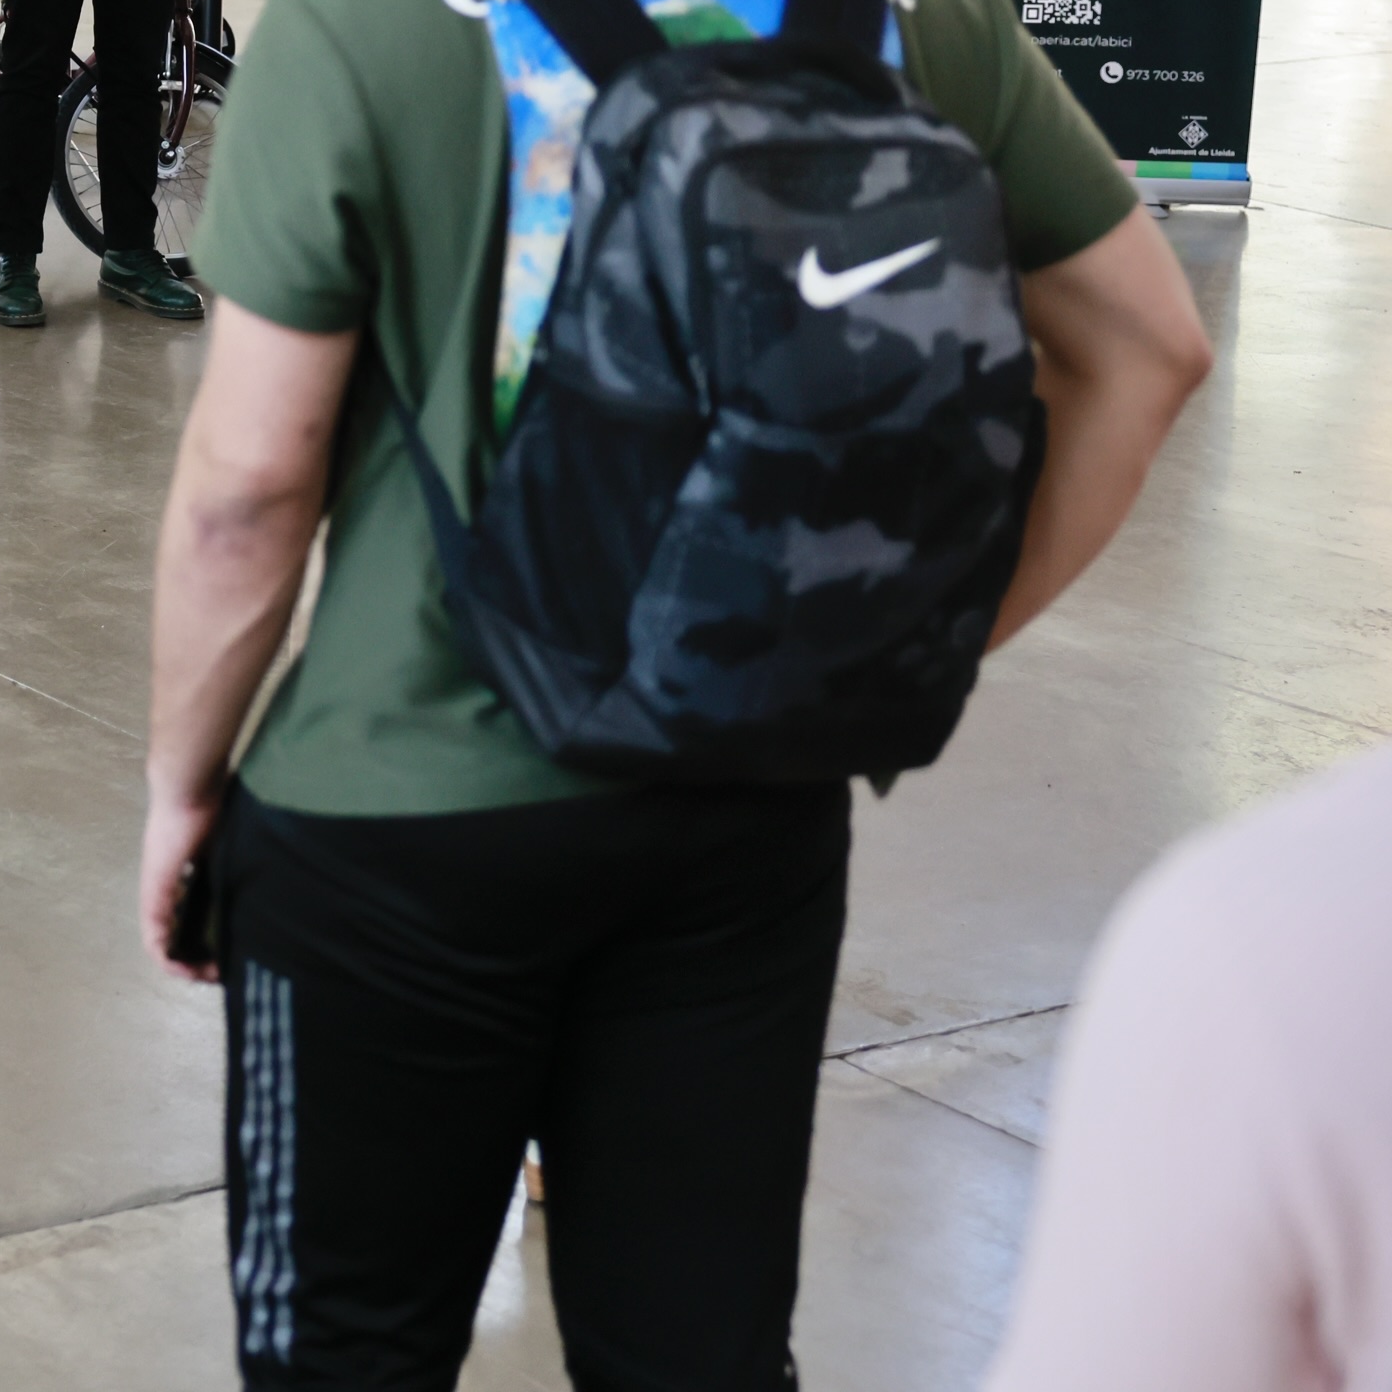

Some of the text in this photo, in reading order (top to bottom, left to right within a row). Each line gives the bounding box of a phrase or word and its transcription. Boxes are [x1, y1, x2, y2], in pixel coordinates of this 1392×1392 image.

[1126, 69, 1205, 82] 973 700 326
